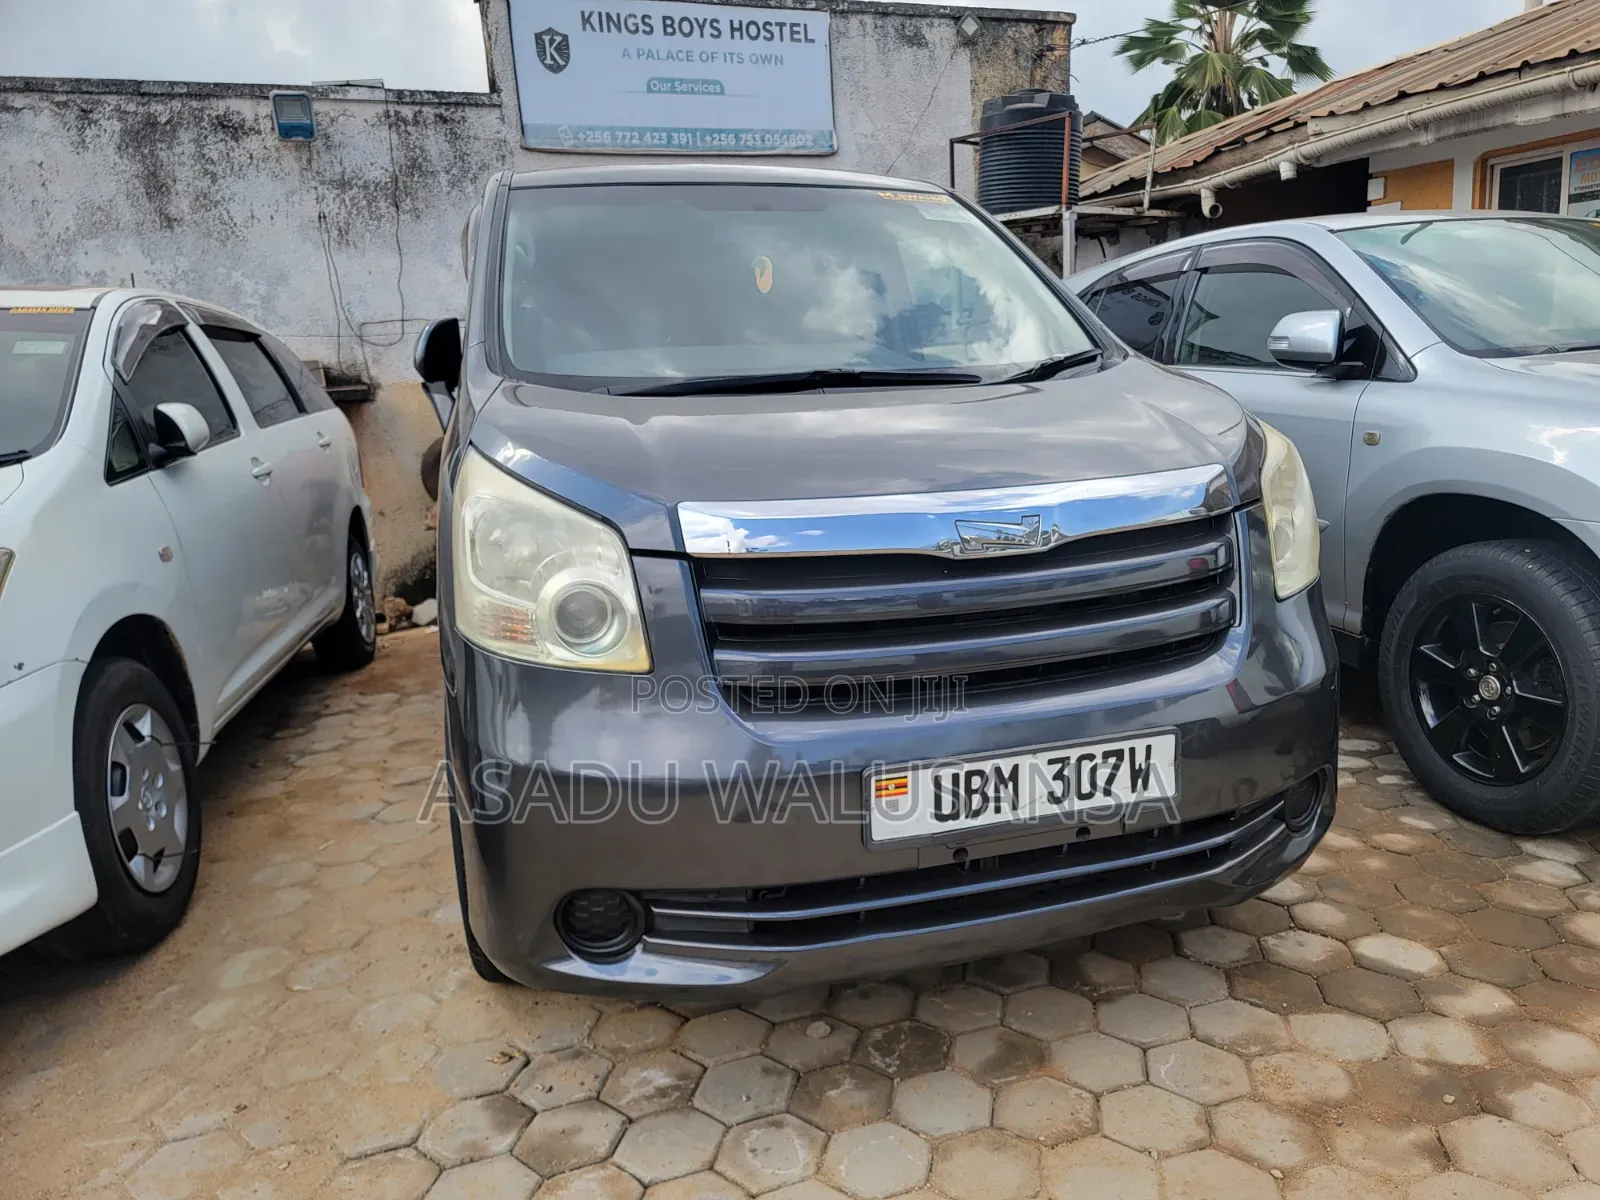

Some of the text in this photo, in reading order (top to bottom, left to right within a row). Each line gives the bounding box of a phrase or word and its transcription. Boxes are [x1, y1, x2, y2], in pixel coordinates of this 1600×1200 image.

[580, 10, 816, 44] KINGS BOYS HOSTEL
[621, 48, 784, 66] A PALACE OF ITS OWN
[650, 80, 722, 94] Our Services
[578, 130, 611, 143] +256
[615, 131, 640, 143] 772
[643, 131, 668, 144] 423
[671, 132, 693, 145] 391
[705, 133, 736, 145] +256
[740, 133, 761, 146] 753
[933, 744, 1152, 823] UBM 307W
